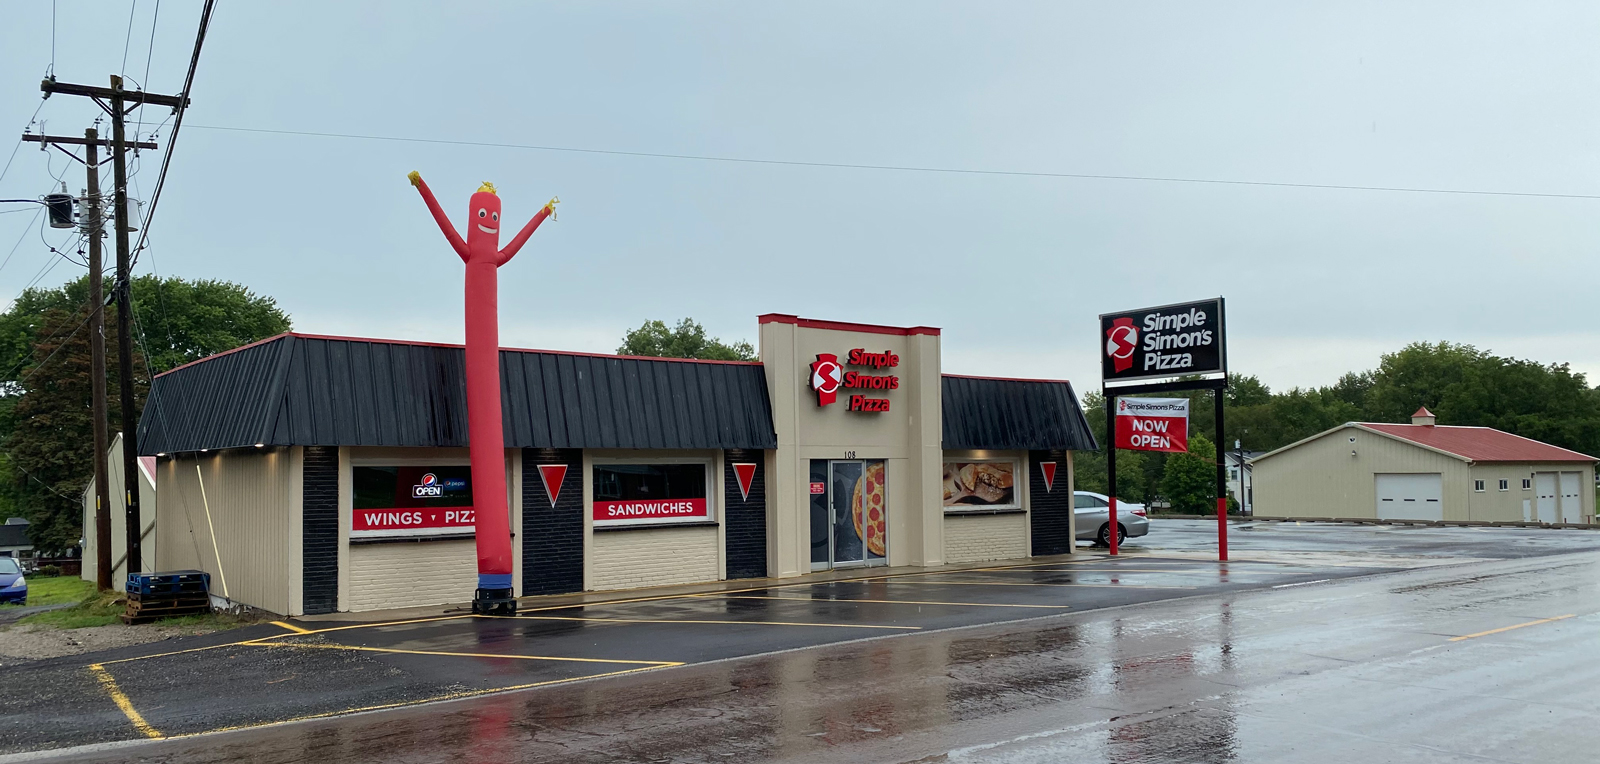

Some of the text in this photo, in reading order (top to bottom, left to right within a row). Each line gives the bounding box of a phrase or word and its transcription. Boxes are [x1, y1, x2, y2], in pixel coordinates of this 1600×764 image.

[1143, 308, 1206, 332] Simple
[1143, 329, 1212, 351] Simon's
[849, 348, 899, 369] Simple
[1144, 352, 1192, 371] Pizza
[844, 371, 899, 389] Simon's
[850, 395, 890, 411] Pizza
[1126, 403, 1145, 411] Simple
[1146, 403, 1168, 411] Simon's
[1132, 419, 1169, 432] NOW
[1131, 435, 1170, 448] OPEN
[844, 450, 856, 459] 108
[415, 487, 441, 496] OPEN
[608, 502, 693, 516] SANDWICHES
[365, 512, 422, 525] WINGS
